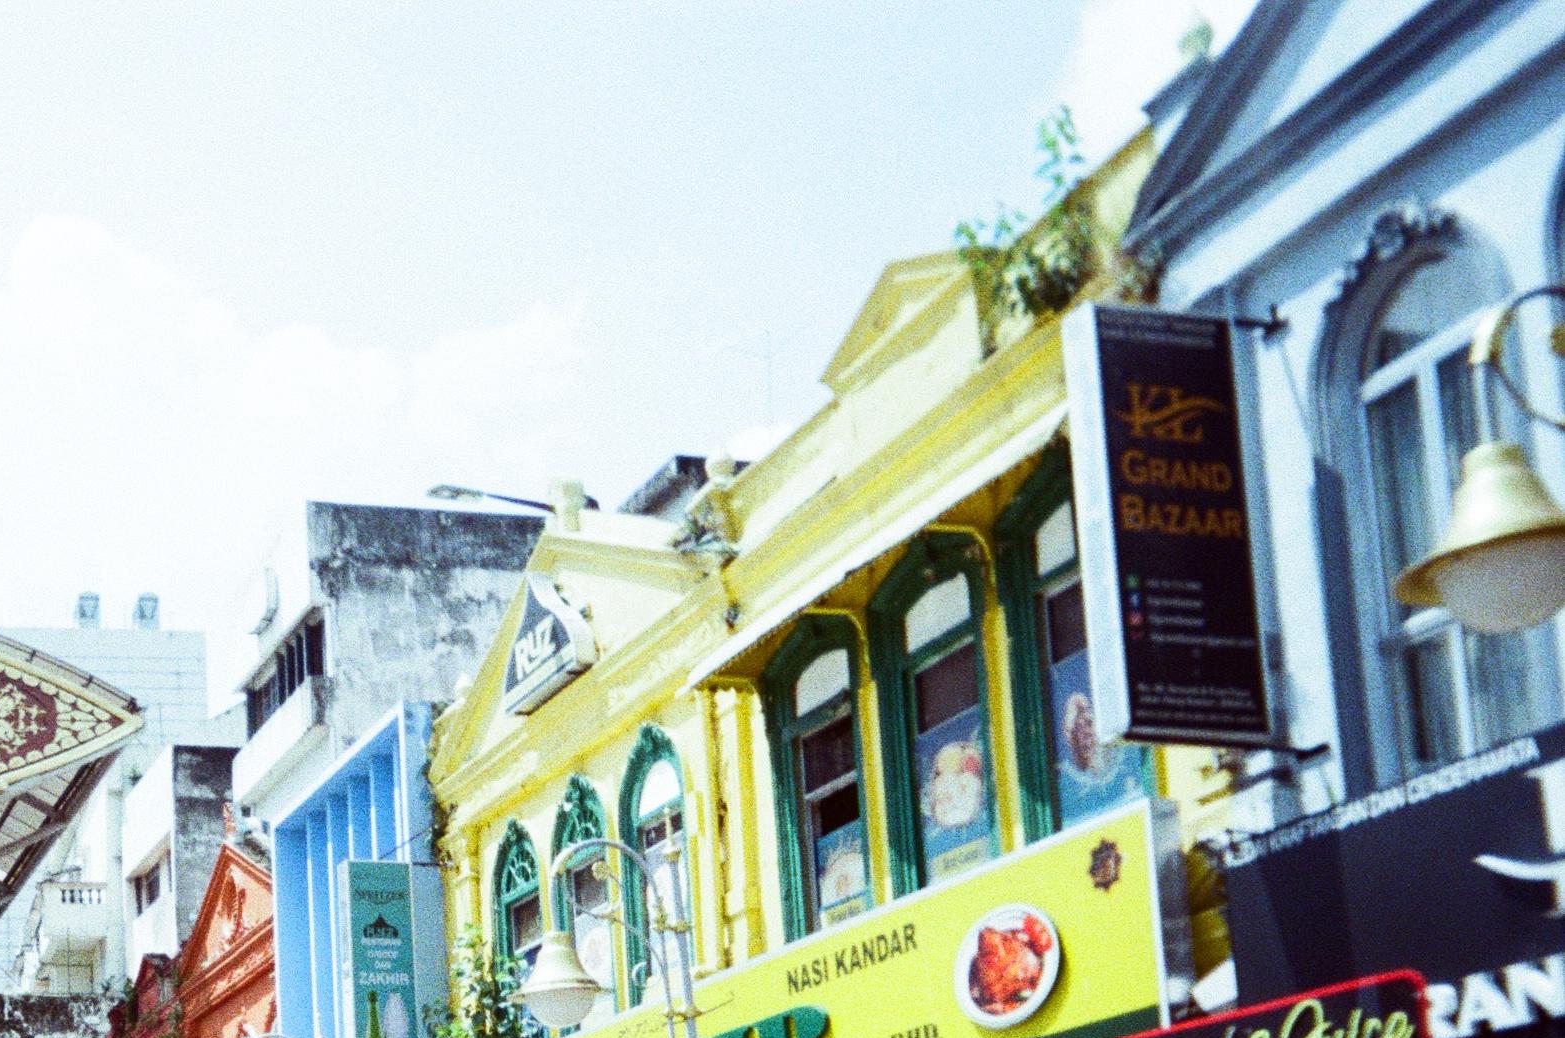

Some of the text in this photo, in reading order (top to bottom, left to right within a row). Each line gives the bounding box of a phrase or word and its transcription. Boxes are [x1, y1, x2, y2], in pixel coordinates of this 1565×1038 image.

[1121, 383, 1220, 443] KL
[1121, 448, 1232, 492] GRAND
[1120, 493, 1243, 537] BAZAAR
[359, 972, 410, 986] ZAKHIR
[787, 923, 917, 996] NASI KANDAR
